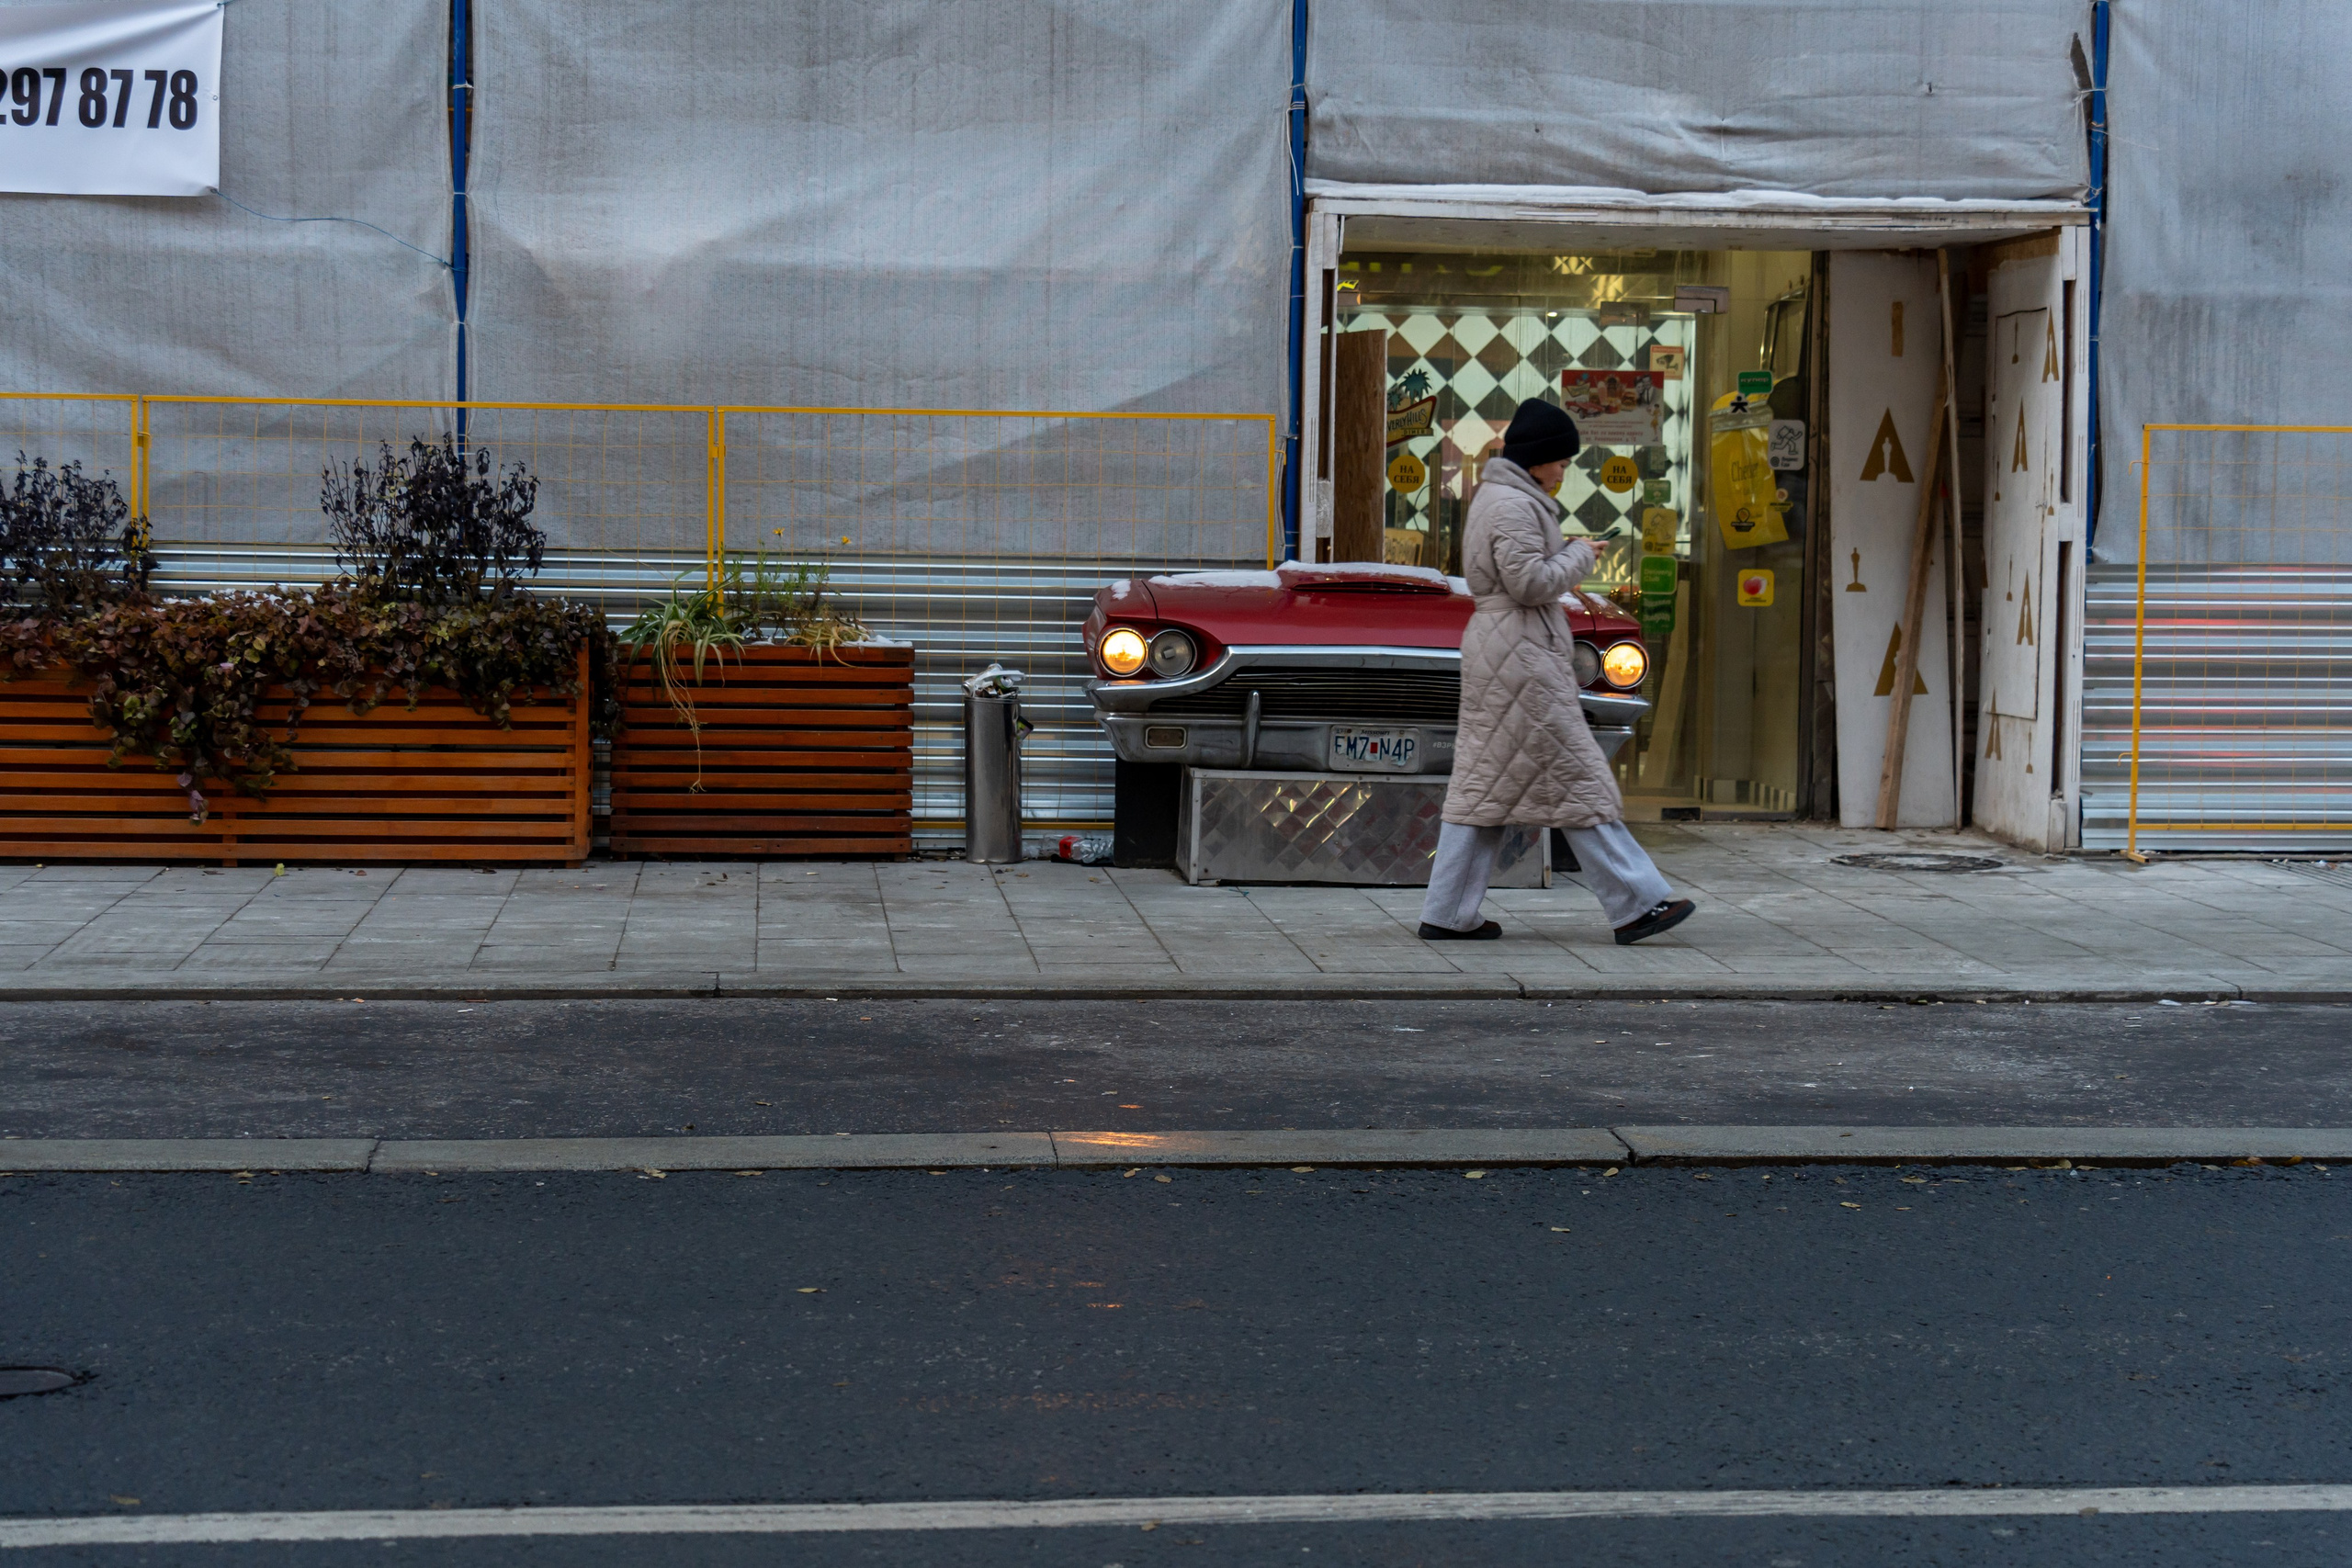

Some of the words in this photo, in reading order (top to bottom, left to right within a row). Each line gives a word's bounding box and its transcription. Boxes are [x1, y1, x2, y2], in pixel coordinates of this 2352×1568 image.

[0, 67, 67, 127] 97
[78, 67, 134, 128] 87
[144, 69, 198, 130] 78
[1612, 465, 1627, 474] НА
[1606, 475, 1633, 484] СЕБЯ
[1380, 738, 1415, 761] N4P
